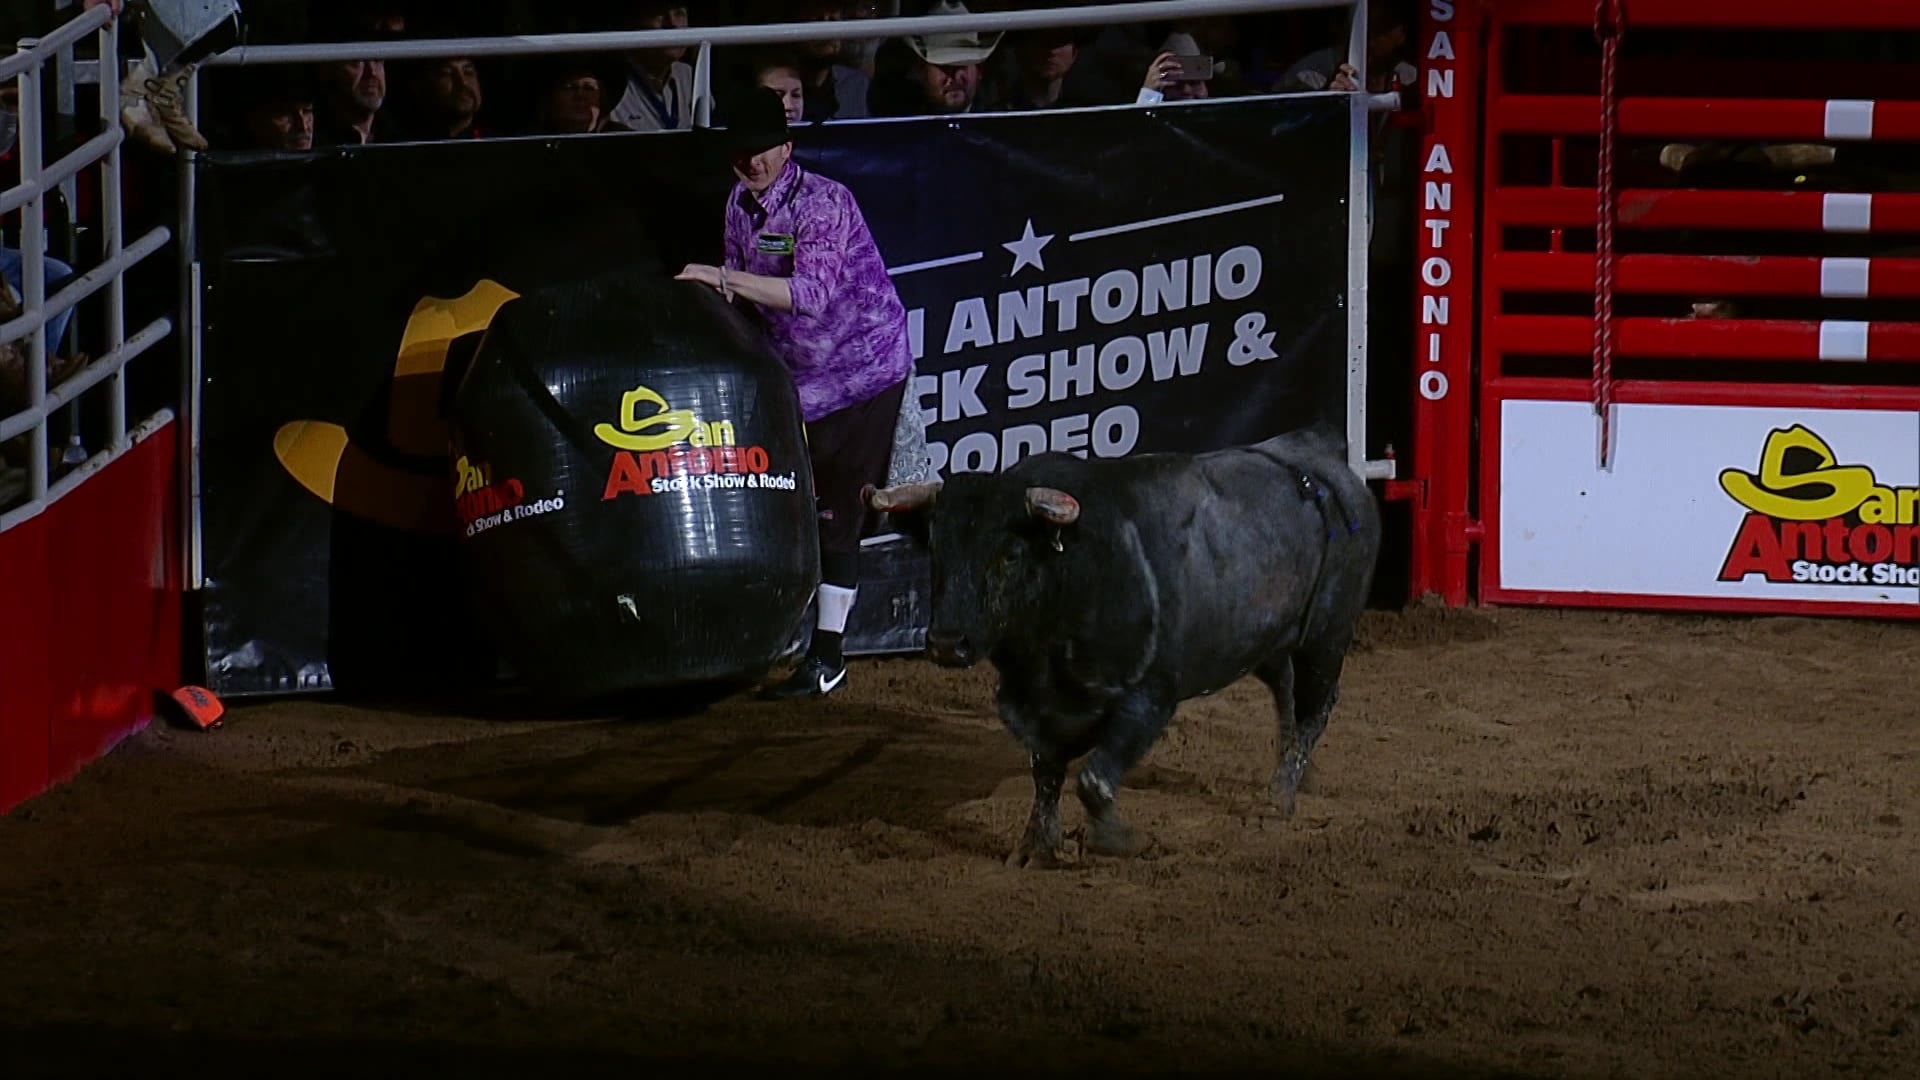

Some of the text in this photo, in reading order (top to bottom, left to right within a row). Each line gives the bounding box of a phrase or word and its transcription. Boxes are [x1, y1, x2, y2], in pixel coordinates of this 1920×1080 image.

[1420, 0, 1455, 401] SAN ANTONIO
[943, 245, 1263, 354] ANTONIO
[1006, 322, 1209, 410] SHOW
[1226, 311, 1279, 367] &
[594, 385, 736, 451] San
[926, 405, 1140, 482] RODEO
[603, 446, 769, 500] Antonio
[651, 472, 796, 493] Stock Show & Rodeo
[503, 509, 513, 523] &
[514, 497, 565, 519] Rodeo
[1791, 560, 1868, 583] Stock
